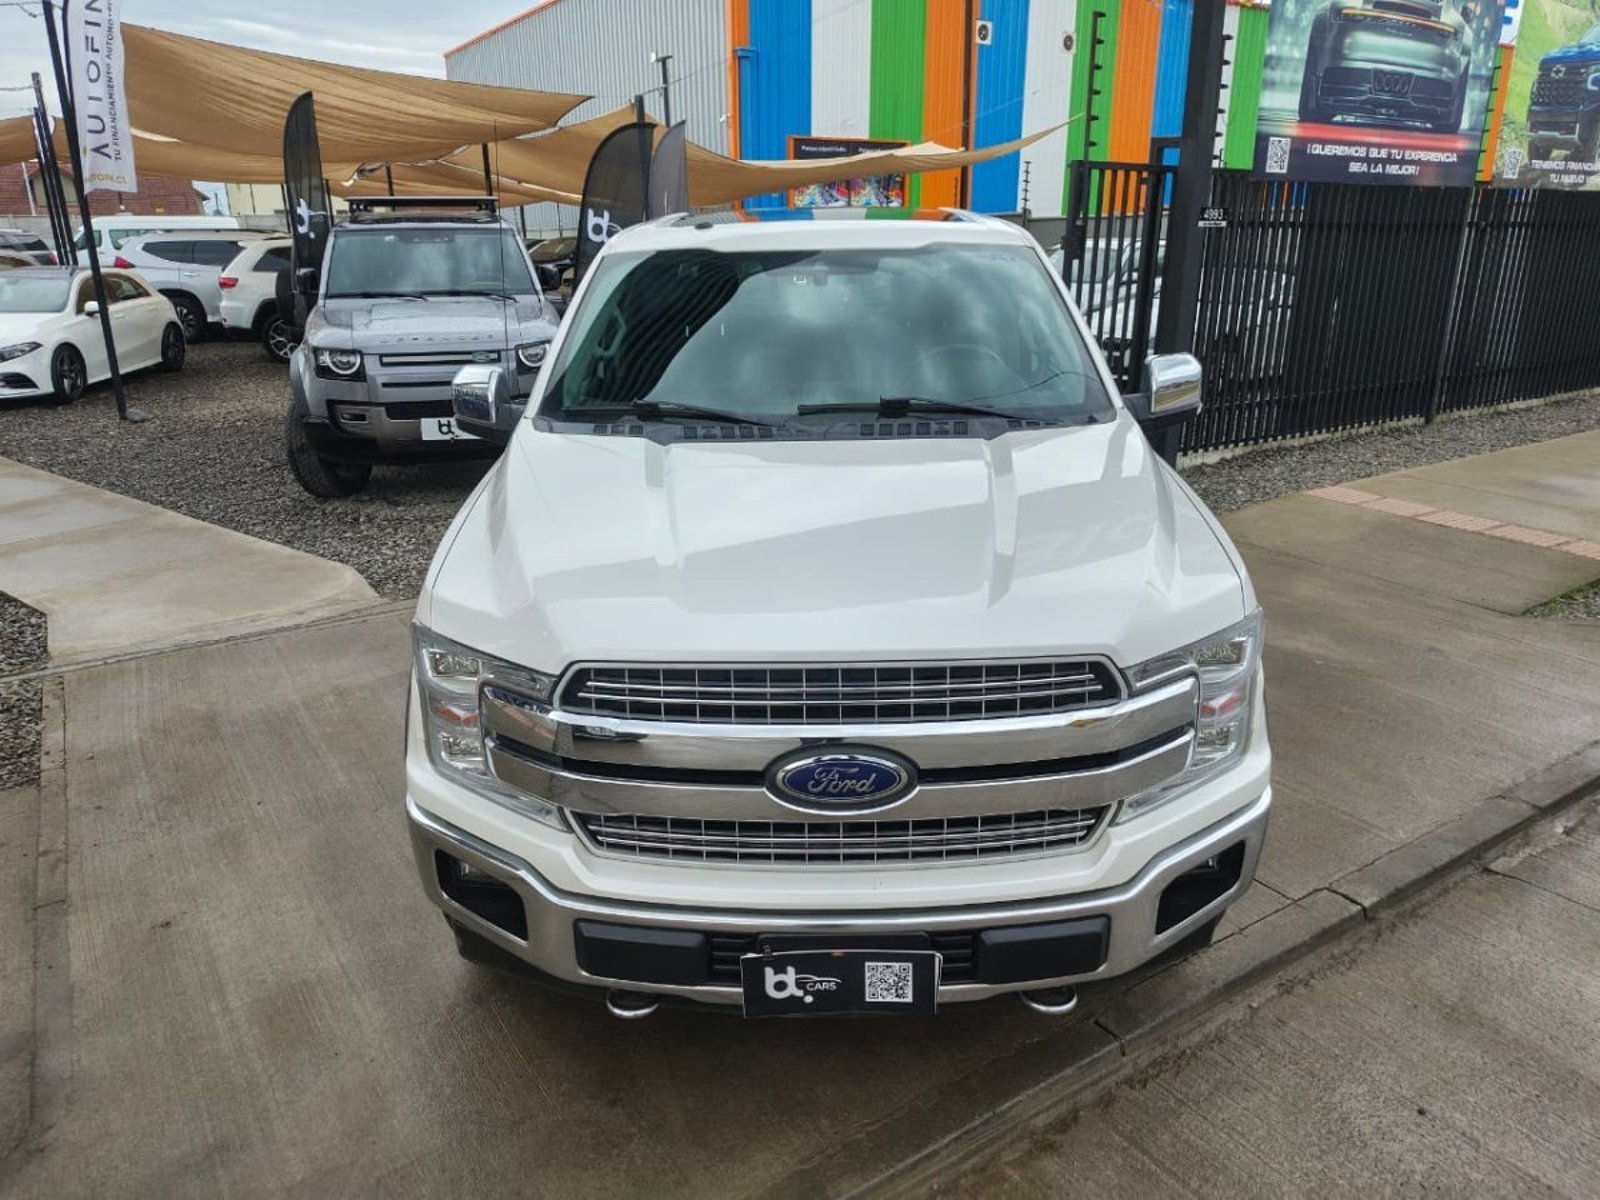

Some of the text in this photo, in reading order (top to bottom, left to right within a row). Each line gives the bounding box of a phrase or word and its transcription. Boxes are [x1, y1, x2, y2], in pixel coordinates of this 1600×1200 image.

[1368, 147, 1389, 159] QUE
[1391, 149, 1402, 160] TU
[1348, 162, 1368, 172] SEA
[1370, 163, 1383, 174] LA
[807, 767, 877, 793] Ford
[806, 982, 838, 992] CARS
